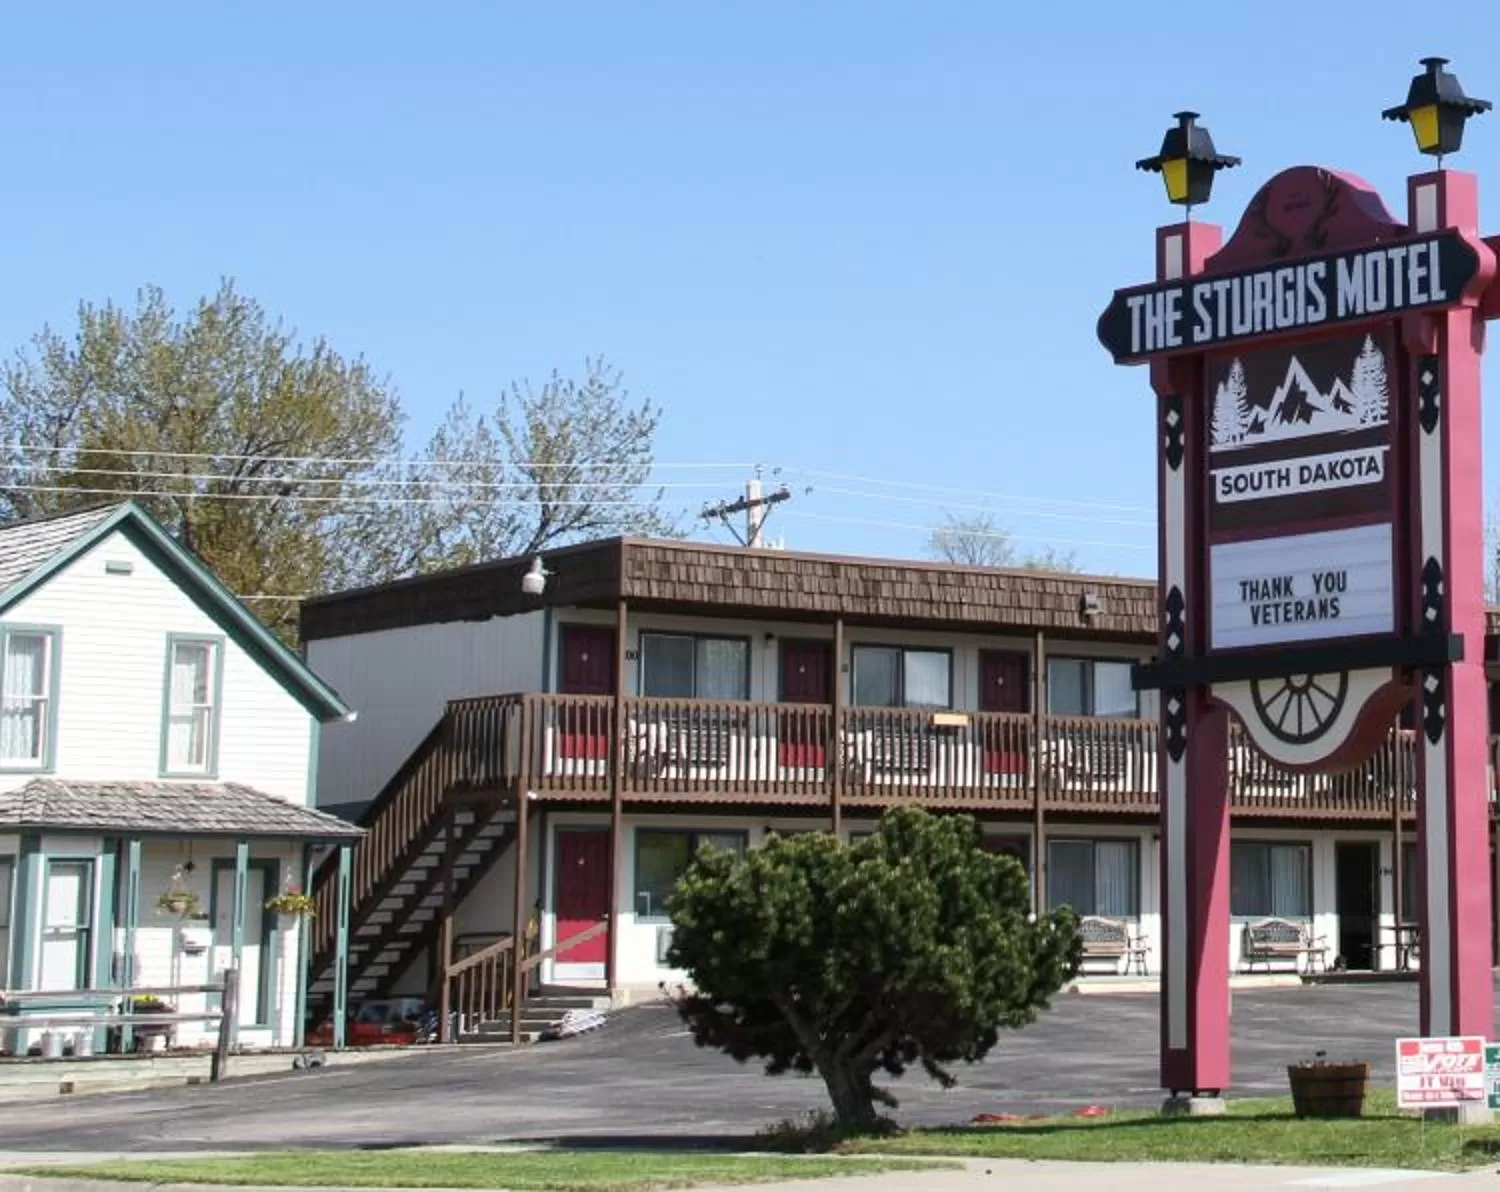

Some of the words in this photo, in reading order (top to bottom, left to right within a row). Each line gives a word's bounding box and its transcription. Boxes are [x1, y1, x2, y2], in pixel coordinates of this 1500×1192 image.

[1127, 288, 1183, 353] THE
[1193, 260, 1328, 344] STURGIS
[1336, 239, 1447, 318] MOTEL
[1221, 467, 1291, 495] SOUTH
[1299, 455, 1381, 486] DAKOTA
[1239, 575, 1294, 602] THANK
[1312, 570, 1348, 595] YOU
[1250, 597, 1341, 625] VETERANS
